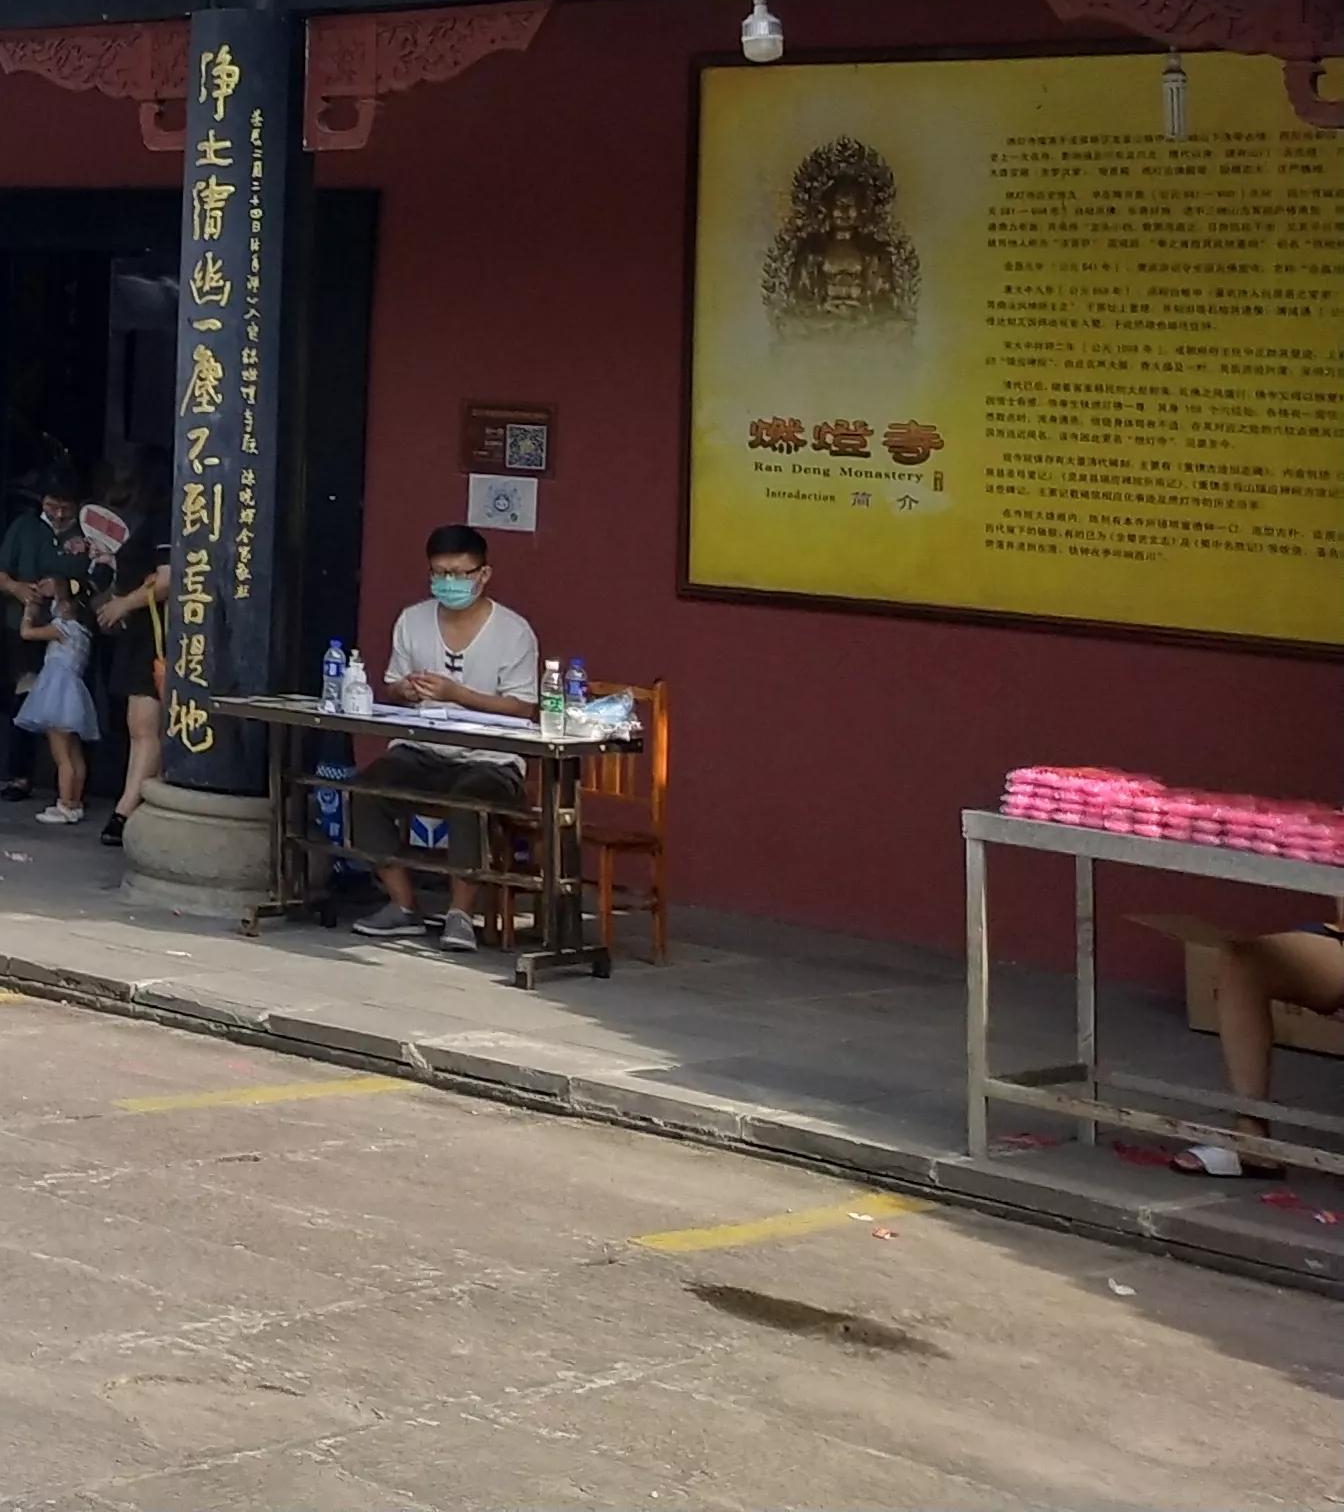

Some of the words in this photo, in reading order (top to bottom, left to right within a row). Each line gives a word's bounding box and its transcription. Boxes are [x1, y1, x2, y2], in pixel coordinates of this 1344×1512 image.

[754, 461, 783, 474] Ran
[792, 464, 831, 477] Deng
[840, 467, 924, 484] Monastery
